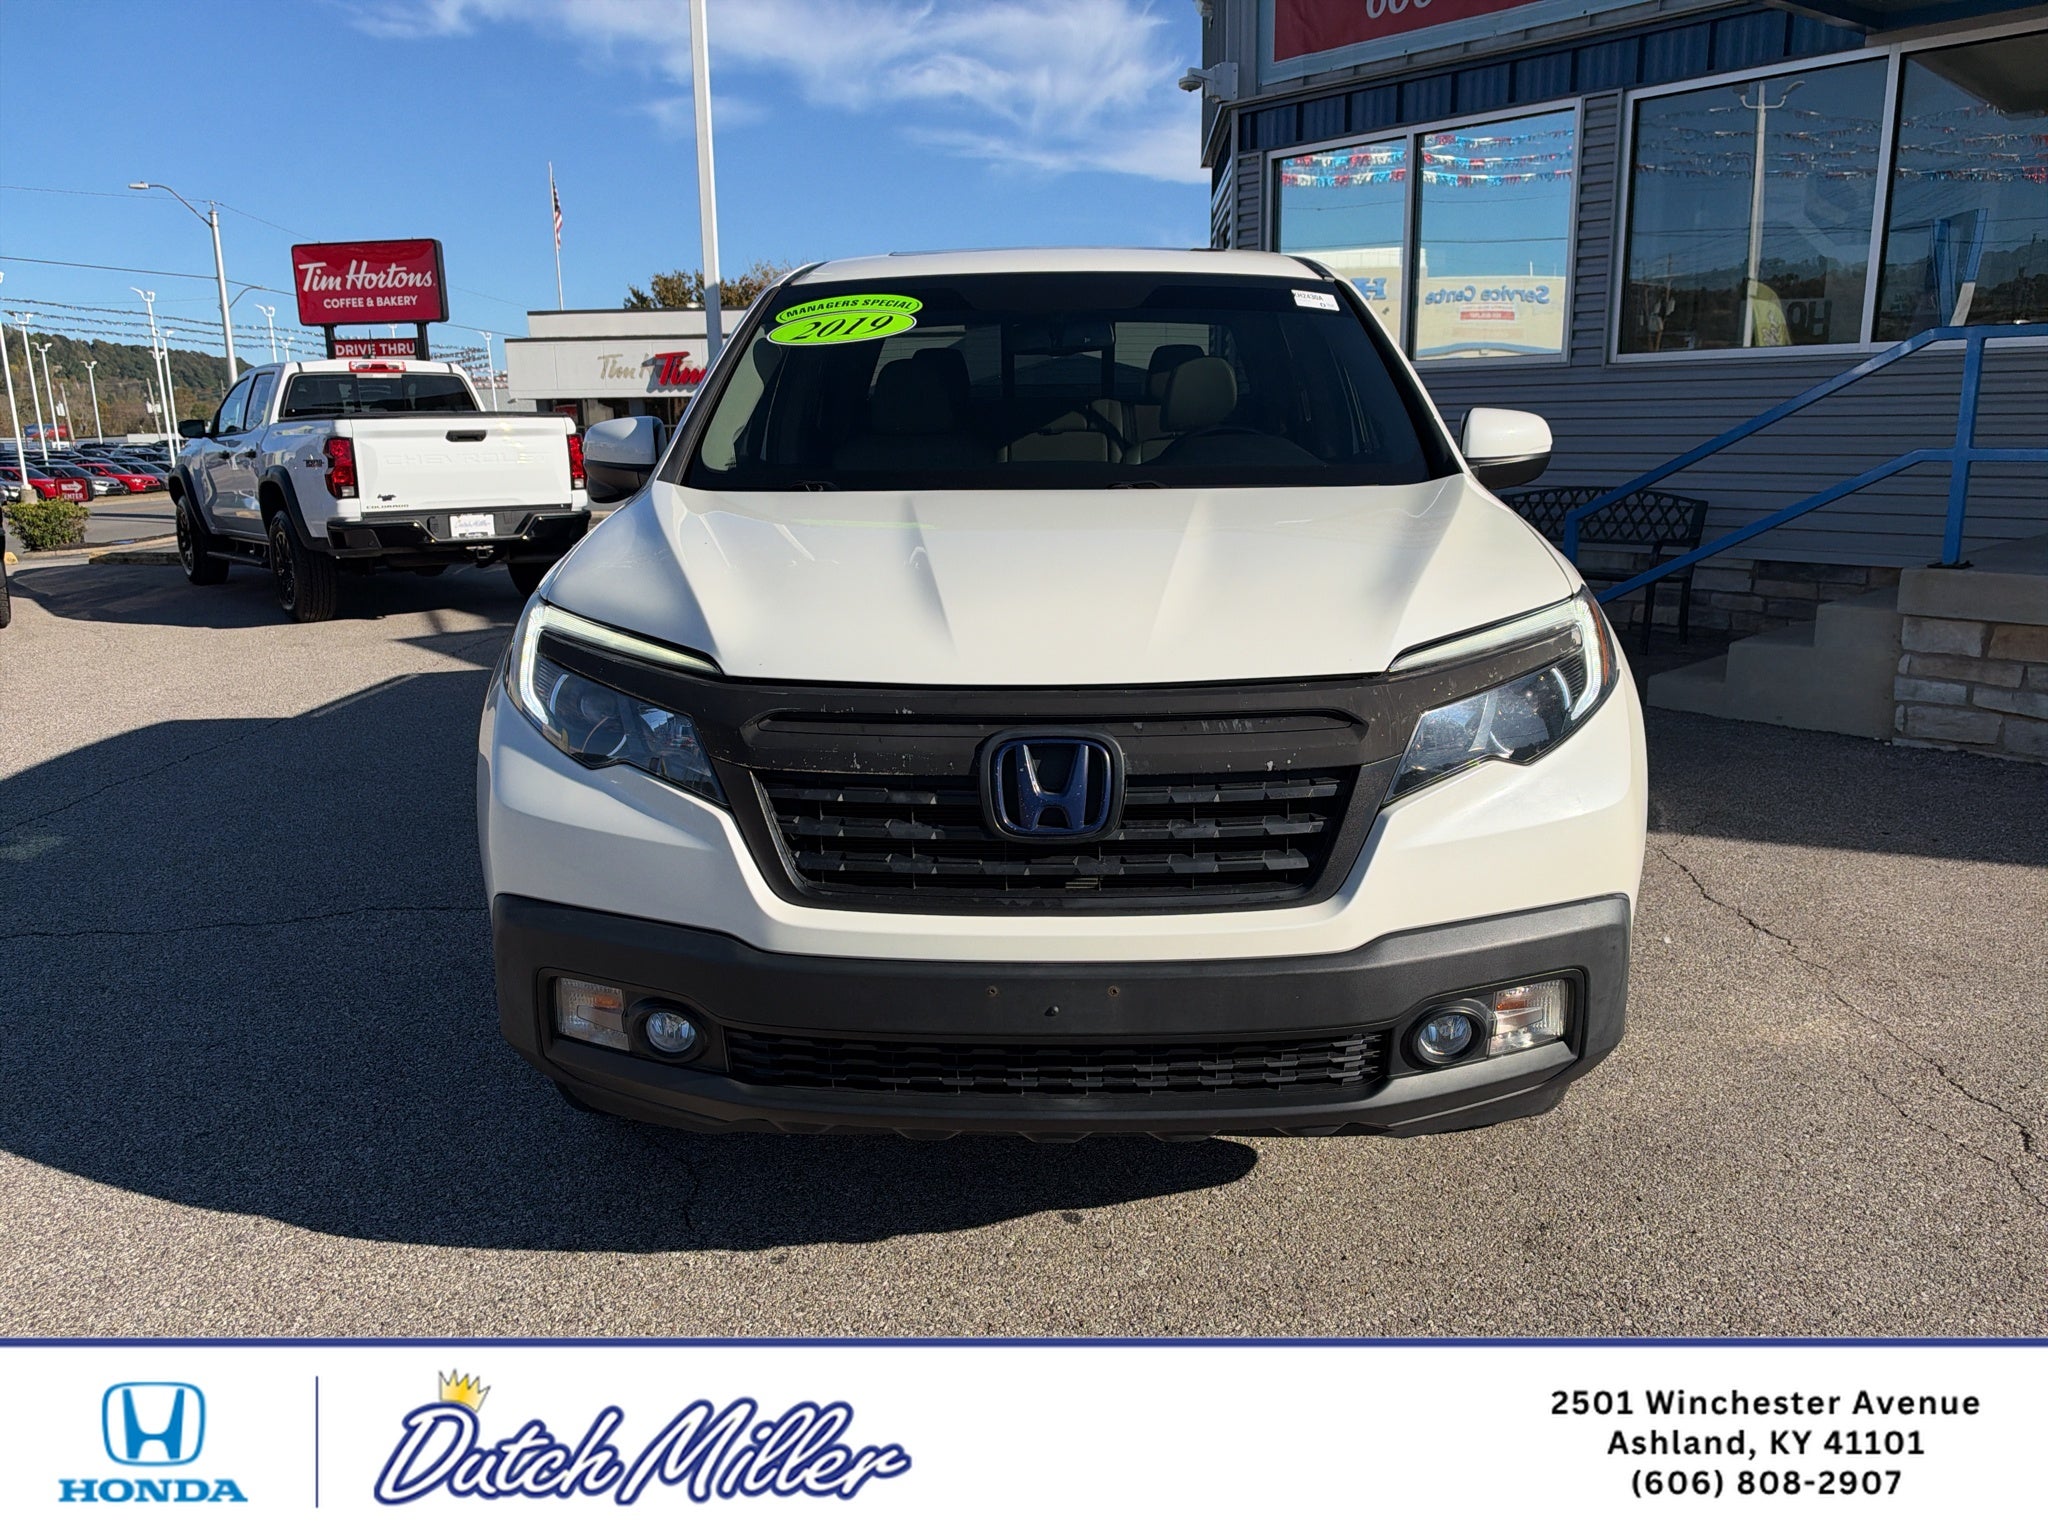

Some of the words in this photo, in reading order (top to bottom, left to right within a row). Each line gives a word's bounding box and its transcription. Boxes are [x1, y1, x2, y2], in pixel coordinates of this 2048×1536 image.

[298, 261, 342, 292] Tim
[345, 259, 433, 290] Hortons
[323, 297, 365, 309] COFFEE
[366, 296, 375, 307] &
[376, 295, 418, 307] BAKERY
[786, 298, 860, 319] MANAGERS
[862, 299, 913, 310] SPECIAL
[789, 314, 895, 342] 2019
[335, 343, 376, 356] DRIVE
[379, 341, 416, 354] THRU
